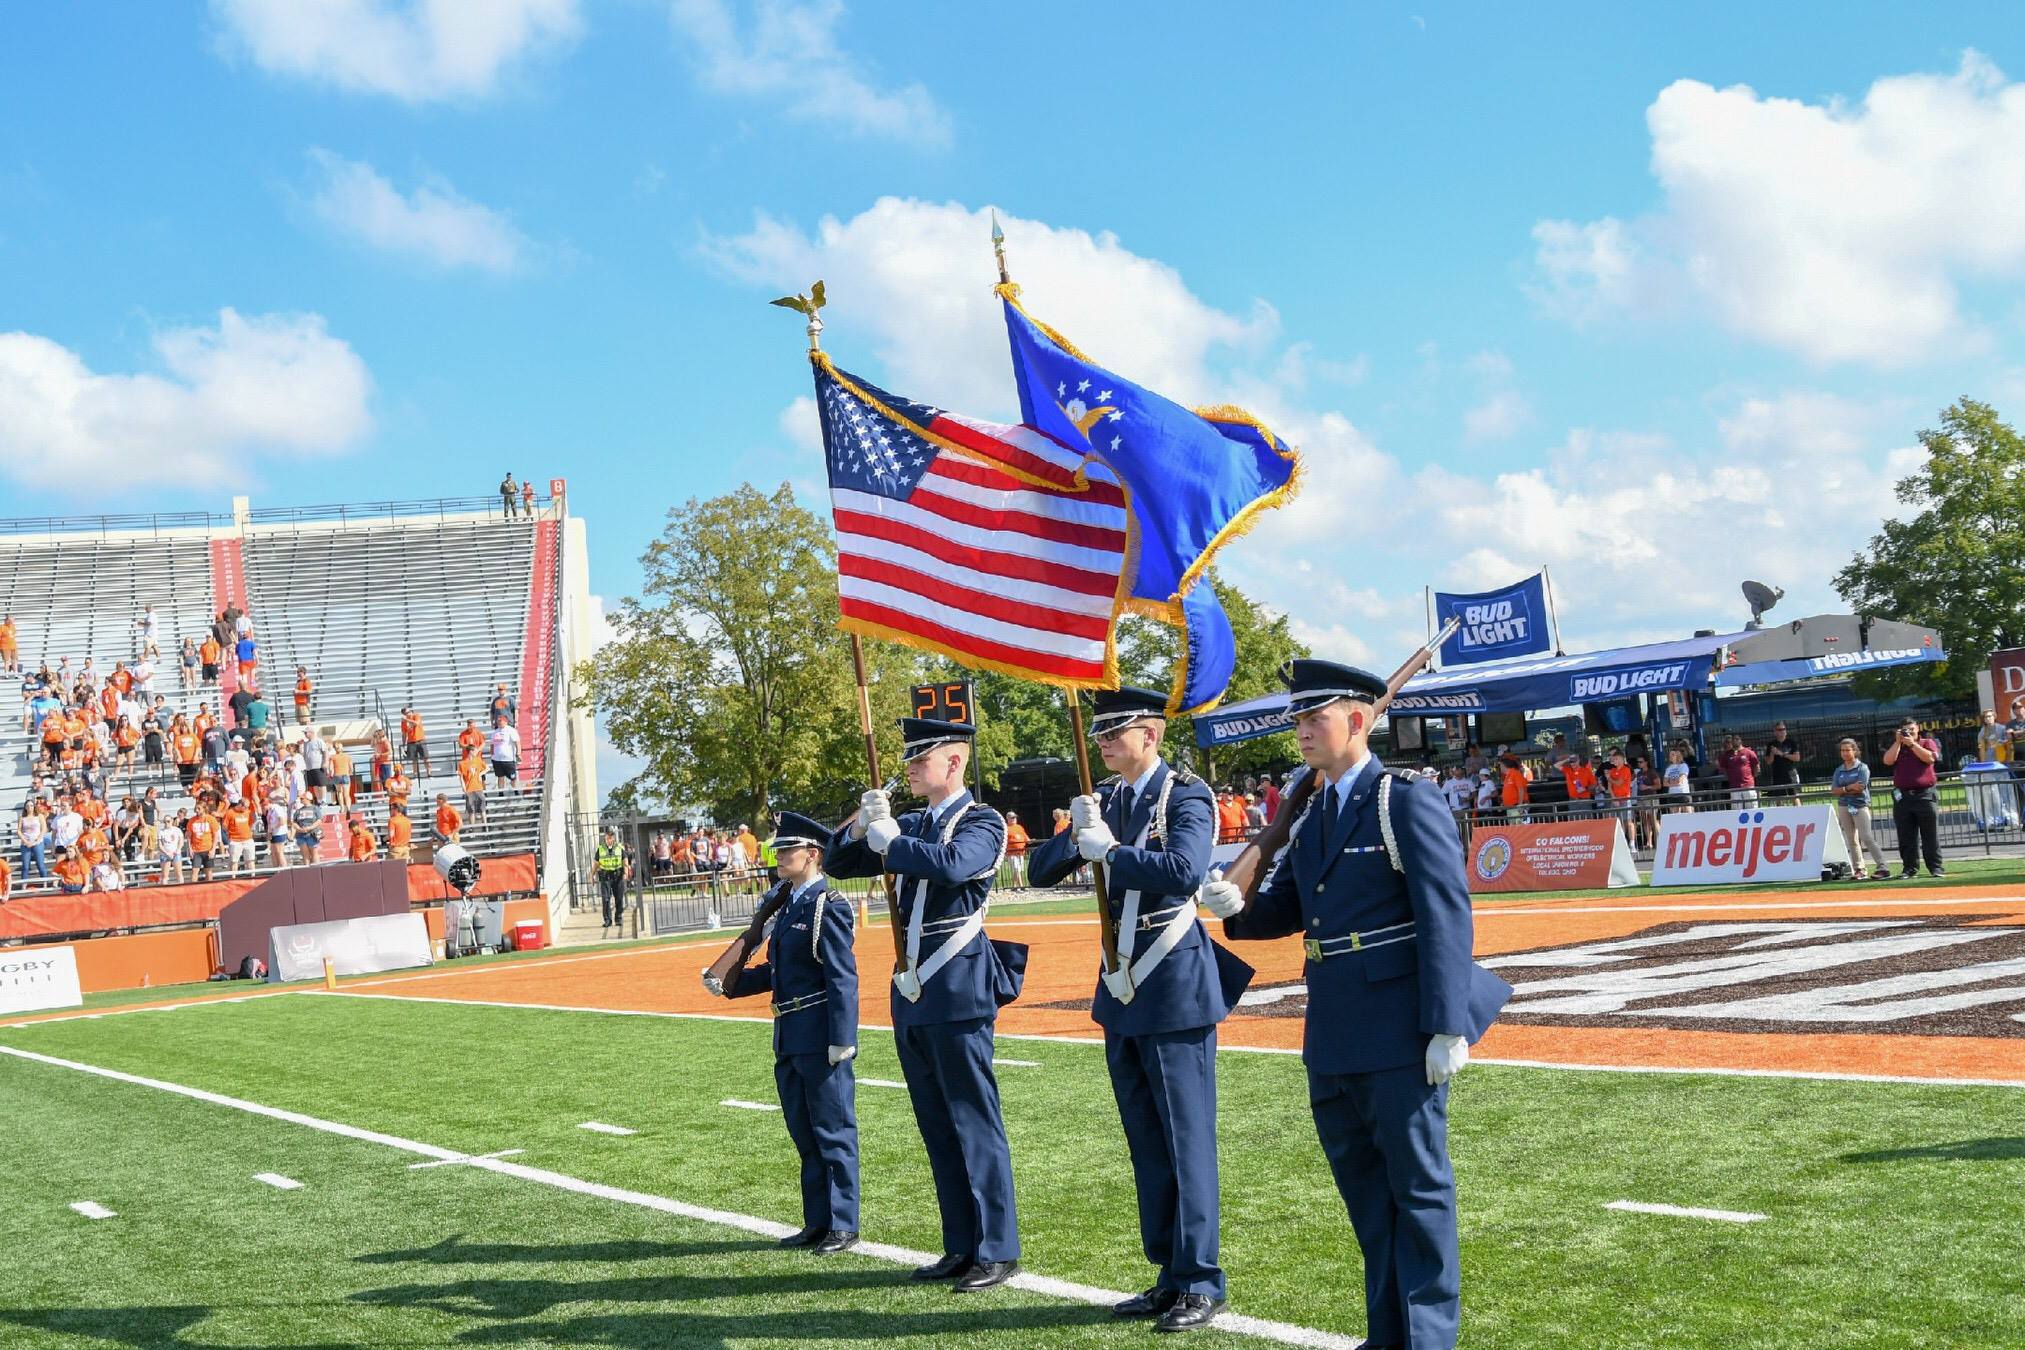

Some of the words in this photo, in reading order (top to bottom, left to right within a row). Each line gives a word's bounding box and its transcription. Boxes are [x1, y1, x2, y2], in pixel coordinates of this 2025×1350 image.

[1465, 600, 1513, 625] BUD
[1462, 617, 1527, 647] LIGHT
[1574, 675, 1618, 697] BUD
[1619, 665, 1685, 690] LIGHT
[917, 685, 967, 723] 25
[1389, 696, 1426, 709] BUD
[1424, 692, 1480, 708] LIGHT
[1213, 720, 1251, 739] BUD
[1549, 835, 1590, 846] FALCONS!
[1665, 812, 1815, 878] meijer
